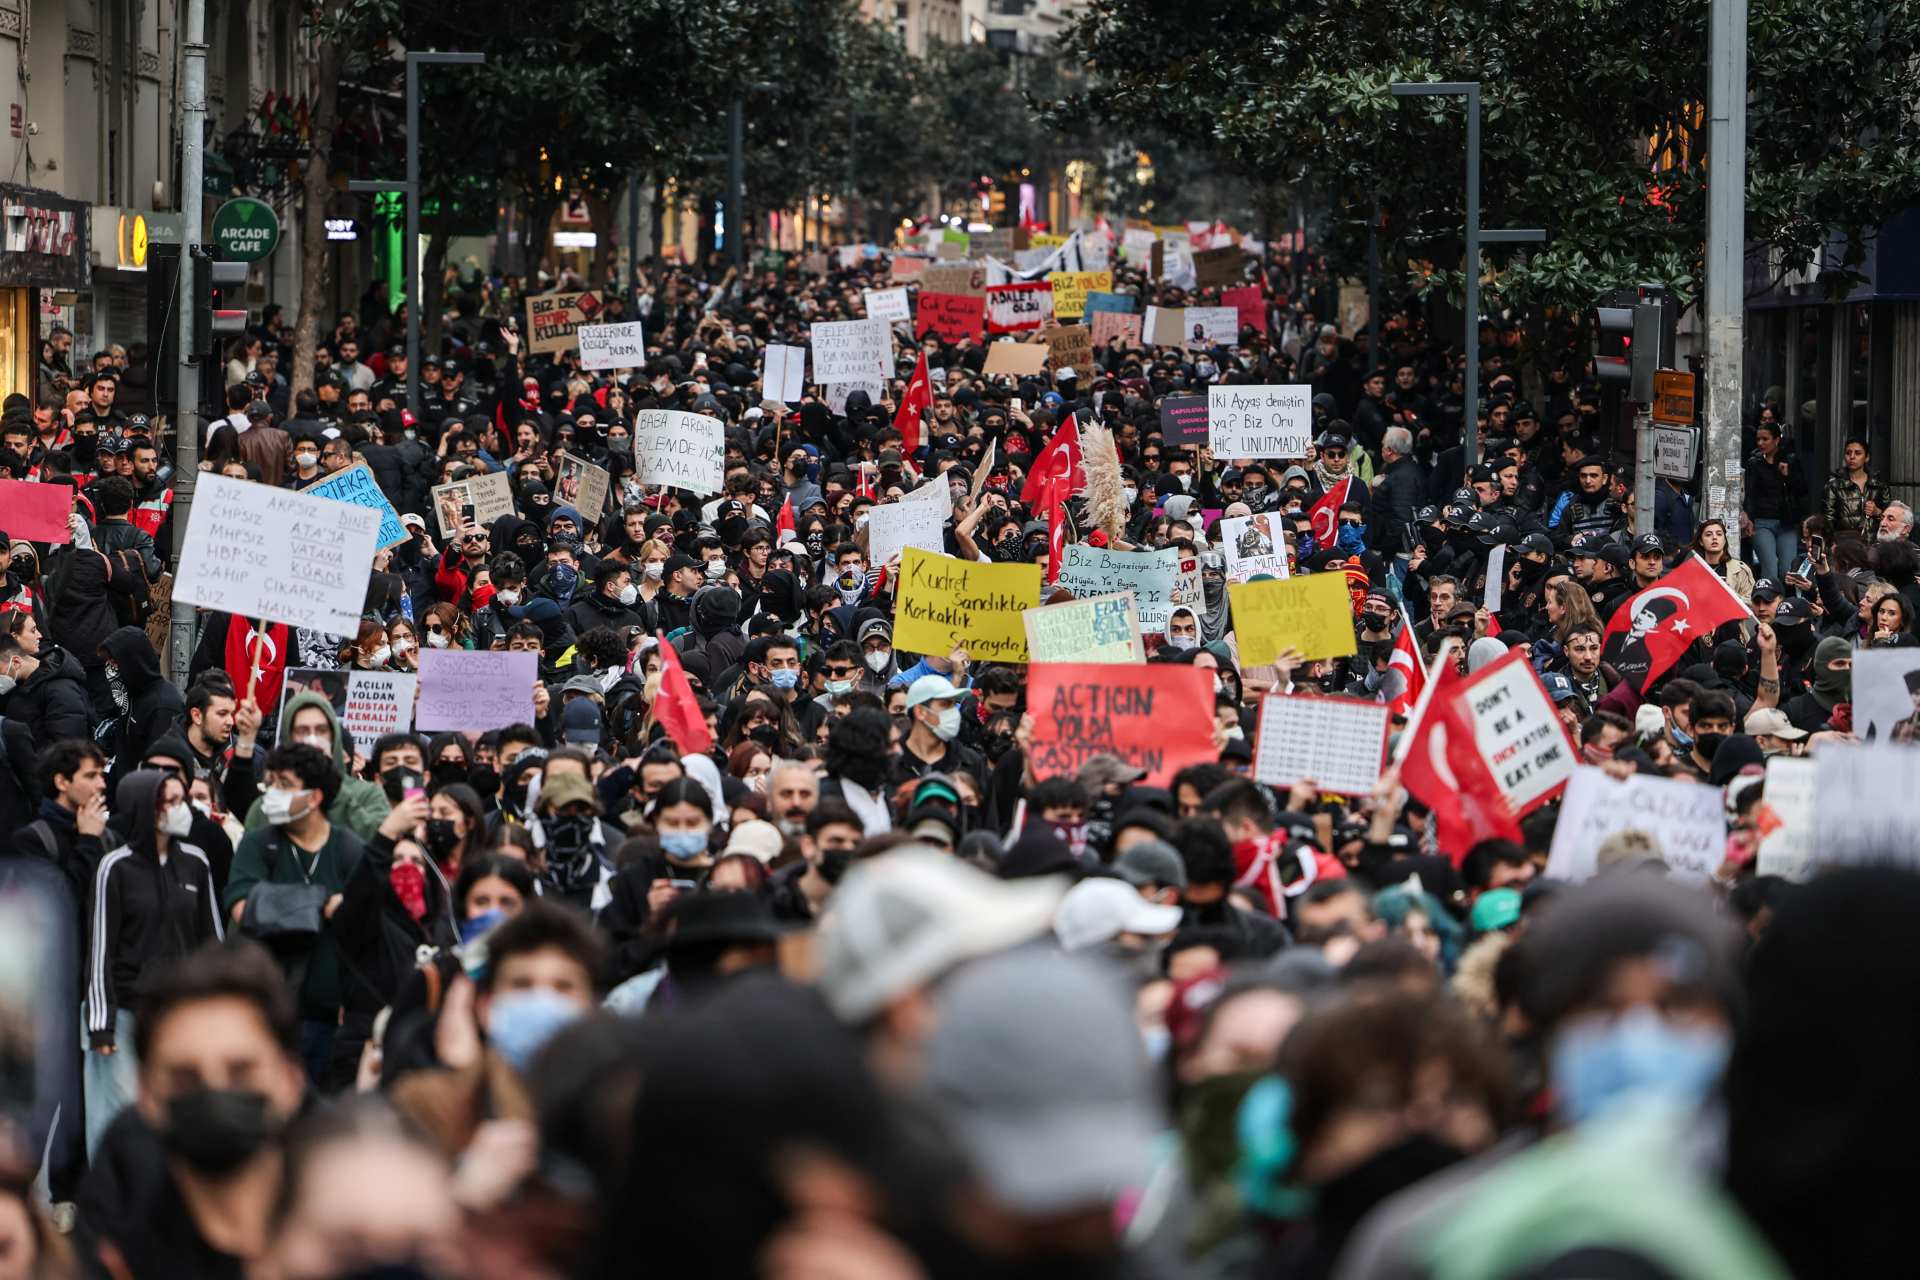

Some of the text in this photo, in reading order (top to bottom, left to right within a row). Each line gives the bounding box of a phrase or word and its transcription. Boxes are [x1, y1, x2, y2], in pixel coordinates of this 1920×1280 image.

[221, 228, 270, 239] ARCADE
[230, 241, 261, 252] CAFE
[558, 297, 576, 308] DE
[1265, 392, 1305, 410] demiştin
[640, 413, 668, 430] BABA
[1212, 413, 1238, 433] ya?
[1244, 413, 1263, 429] Biz
[1241, 436, 1310, 454] UNUTMADIK
[1068, 549, 1092, 567] Biz
[911, 558, 970, 593] Kudret
[356, 680, 394, 692] AÇILIN
[352, 690, 396, 702] YOLDAN
[348, 701, 399, 712] MUSTAFA
[1515, 707, 1525, 723] A
[1504, 748, 1563, 789] EAT ONE
